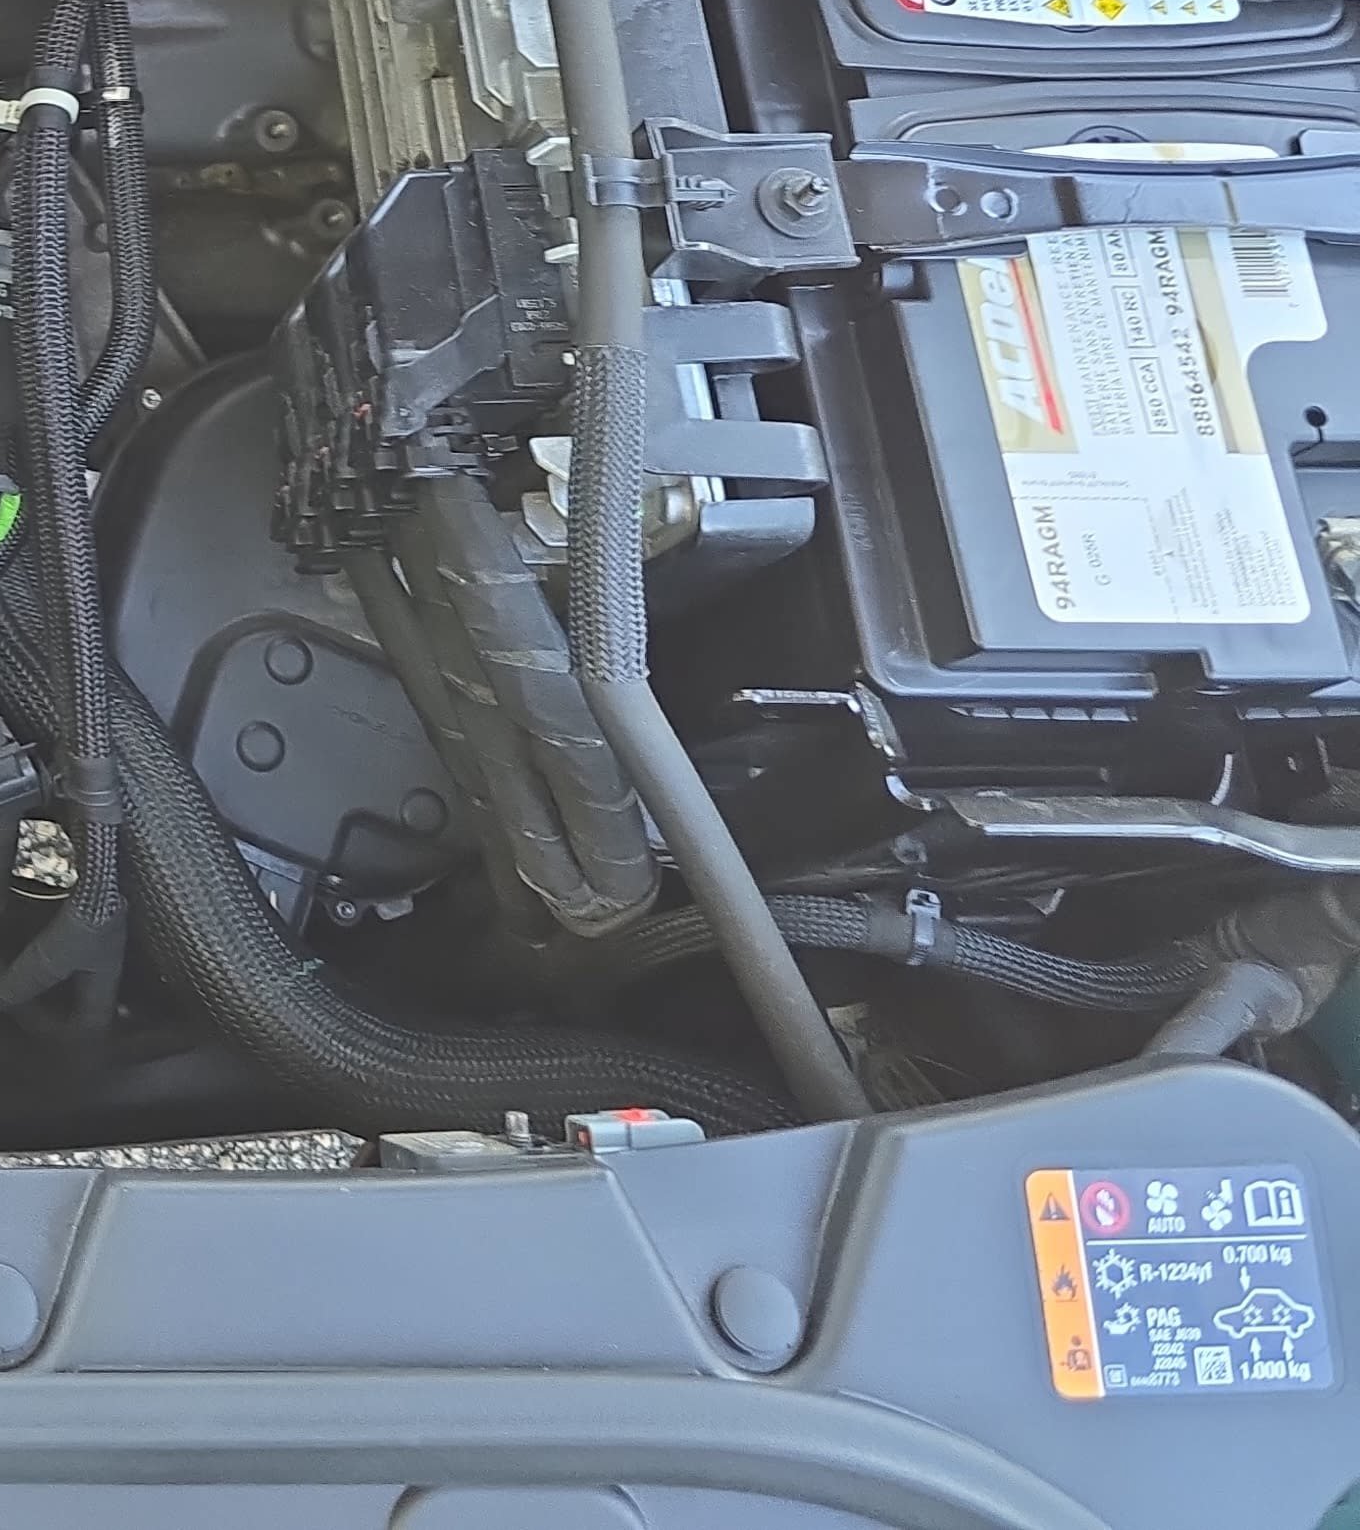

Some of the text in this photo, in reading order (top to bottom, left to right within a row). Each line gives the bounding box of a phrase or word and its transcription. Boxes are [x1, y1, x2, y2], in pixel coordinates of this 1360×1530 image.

[1110, 252, 1128, 271] 80
[1120, 290, 1146, 342] 140 RC
[1146, 229, 1215, 437] 88864542 94RAGM
[1139, 362, 1168, 428] 850 CCA
[1031, 504, 1076, 609] 94RAGM
[1148, 1215, 1186, 1235] AUTO
[1223, 1245, 1293, 1266] 0.700 kg
[1146, 1307, 1182, 1328] PAG
[1239, 1360, 1312, 1383] 1.000 kg
